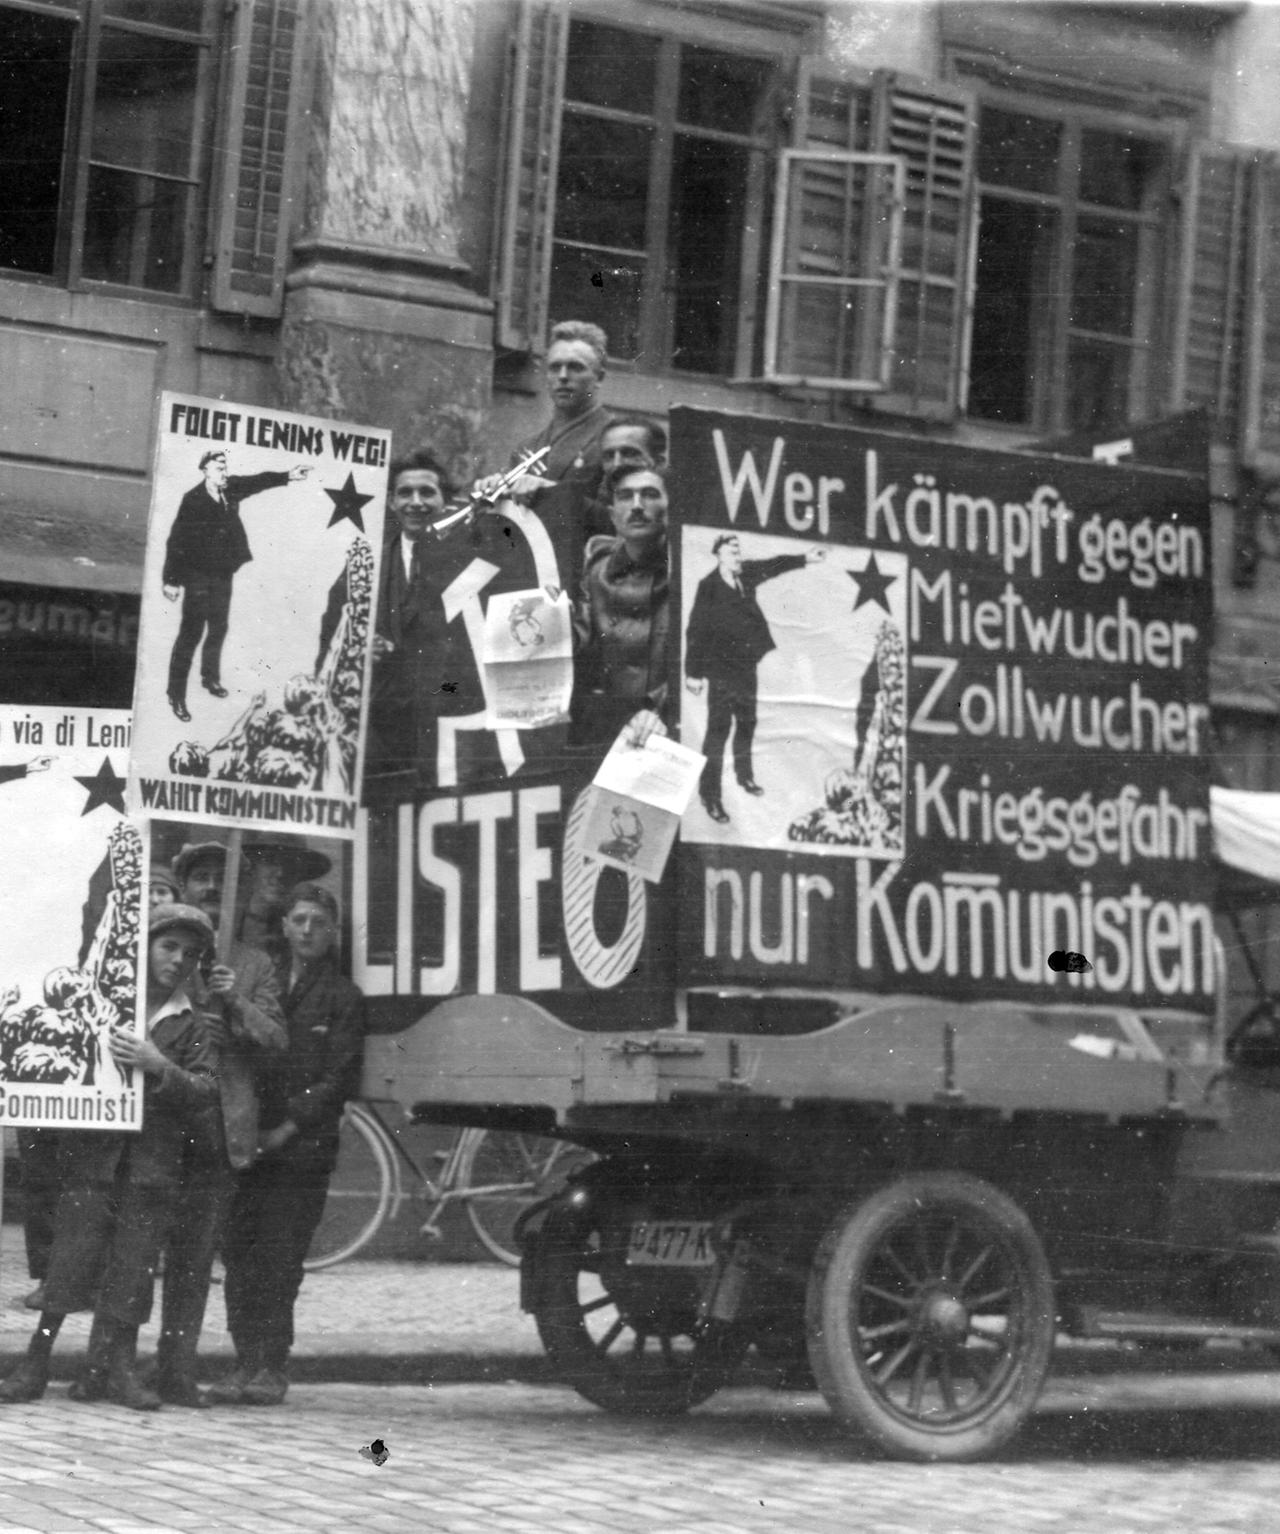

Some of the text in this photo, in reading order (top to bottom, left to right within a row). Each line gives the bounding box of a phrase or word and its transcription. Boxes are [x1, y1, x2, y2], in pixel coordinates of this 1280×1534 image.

[170, 403, 387, 468] FOLGT LENINS WEG!
[712, 429, 1204, 588] Wer kämpft gegen
[910, 567, 1199, 670] Mietwucher
[13, 713, 44, 745] via
[56, 715, 76, 746] di
[910, 655, 1211, 756] Zollwucher
[205, 785, 357, 830] KOMMUNISTEN
[915, 762, 1208, 867] Kriegsgefahr
[354, 785, 562, 996] LISTE
[704, 866, 835, 965] nur
